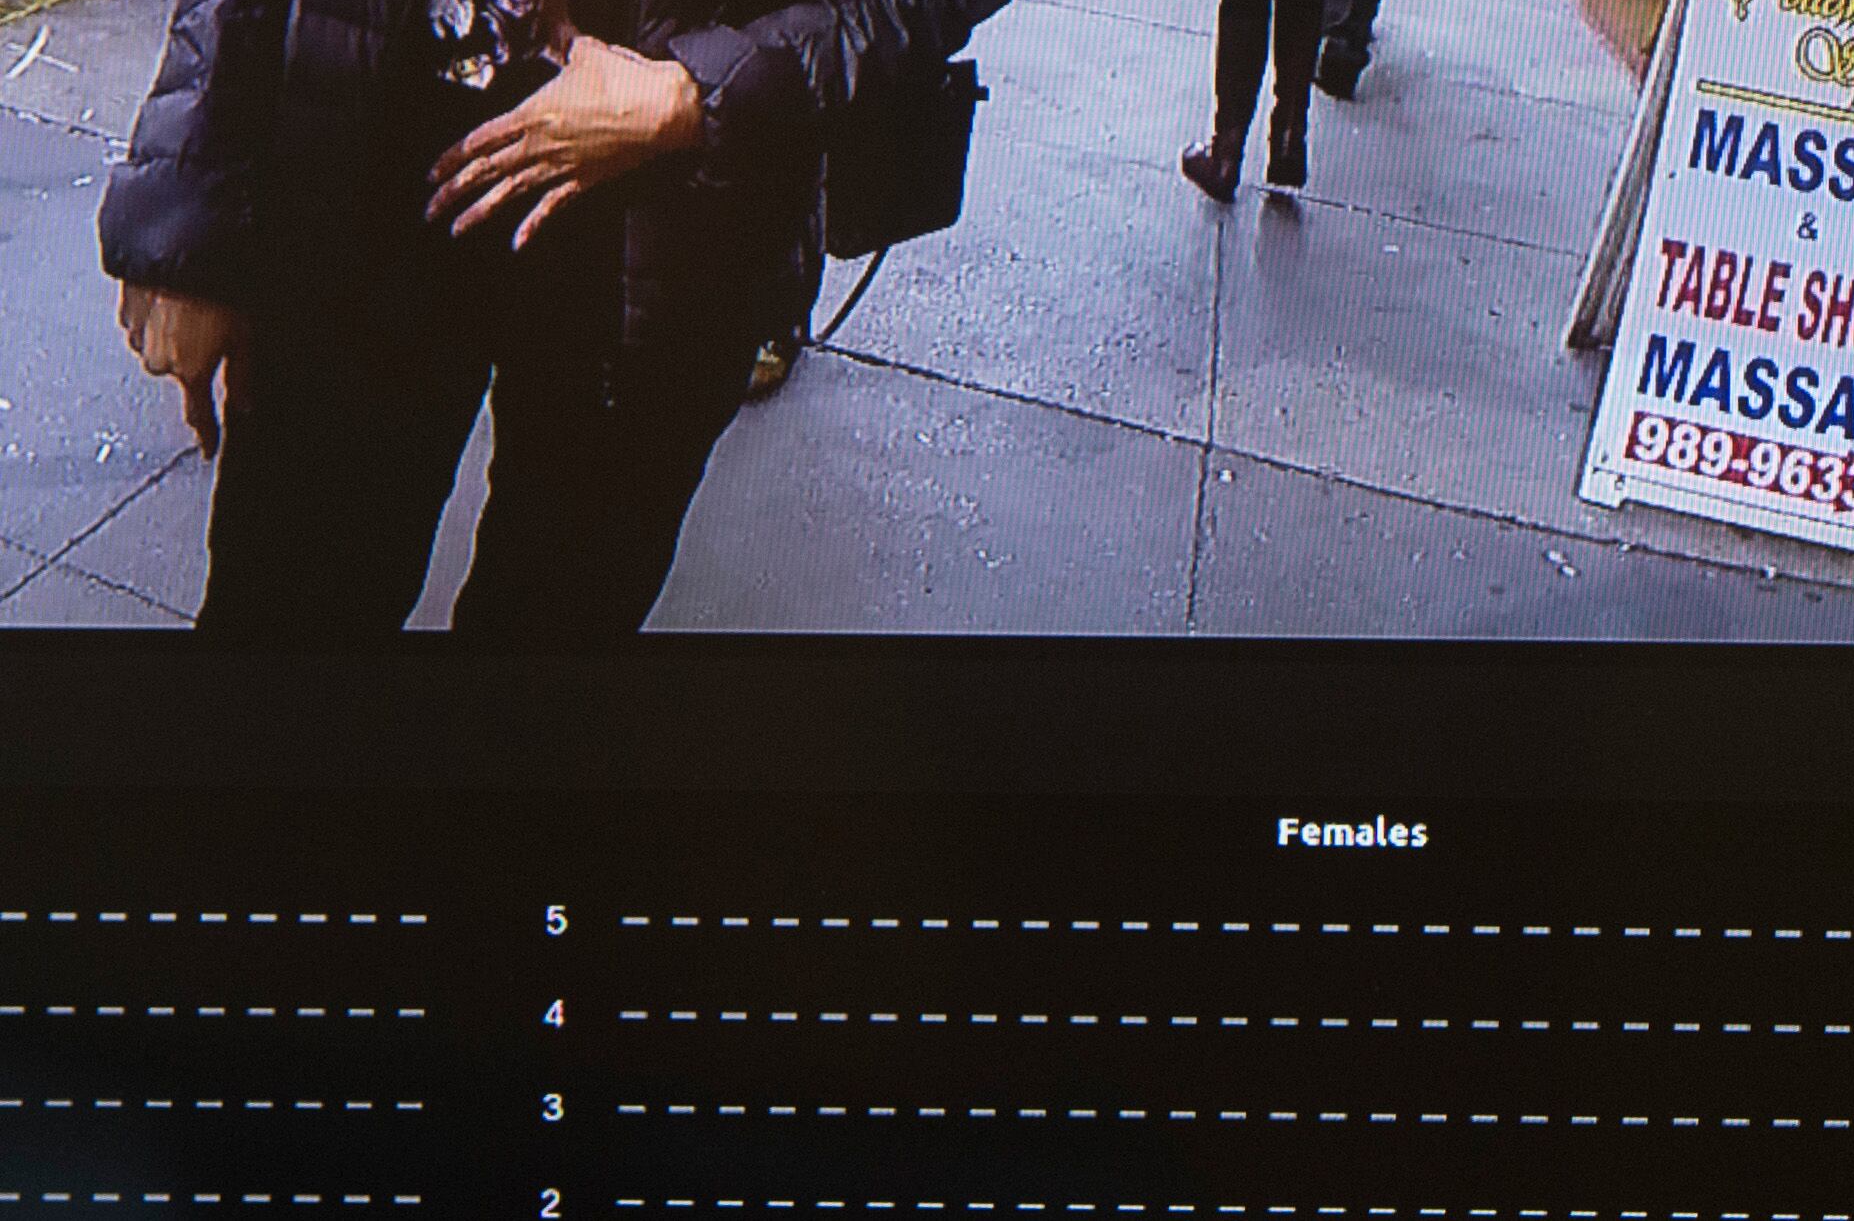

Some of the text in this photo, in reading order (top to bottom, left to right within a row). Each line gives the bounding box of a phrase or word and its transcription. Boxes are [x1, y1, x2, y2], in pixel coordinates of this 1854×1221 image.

[1796, 212, 1819, 241] &
[1656, 237, 1791, 334] TABLE
[1276, 814, 1429, 848] Females
[545, 904, 569, 936] 5
[542, 999, 565, 1029] 4
[541, 1093, 564, 1122] 3
[538, 1188, 561, 1219] 2
